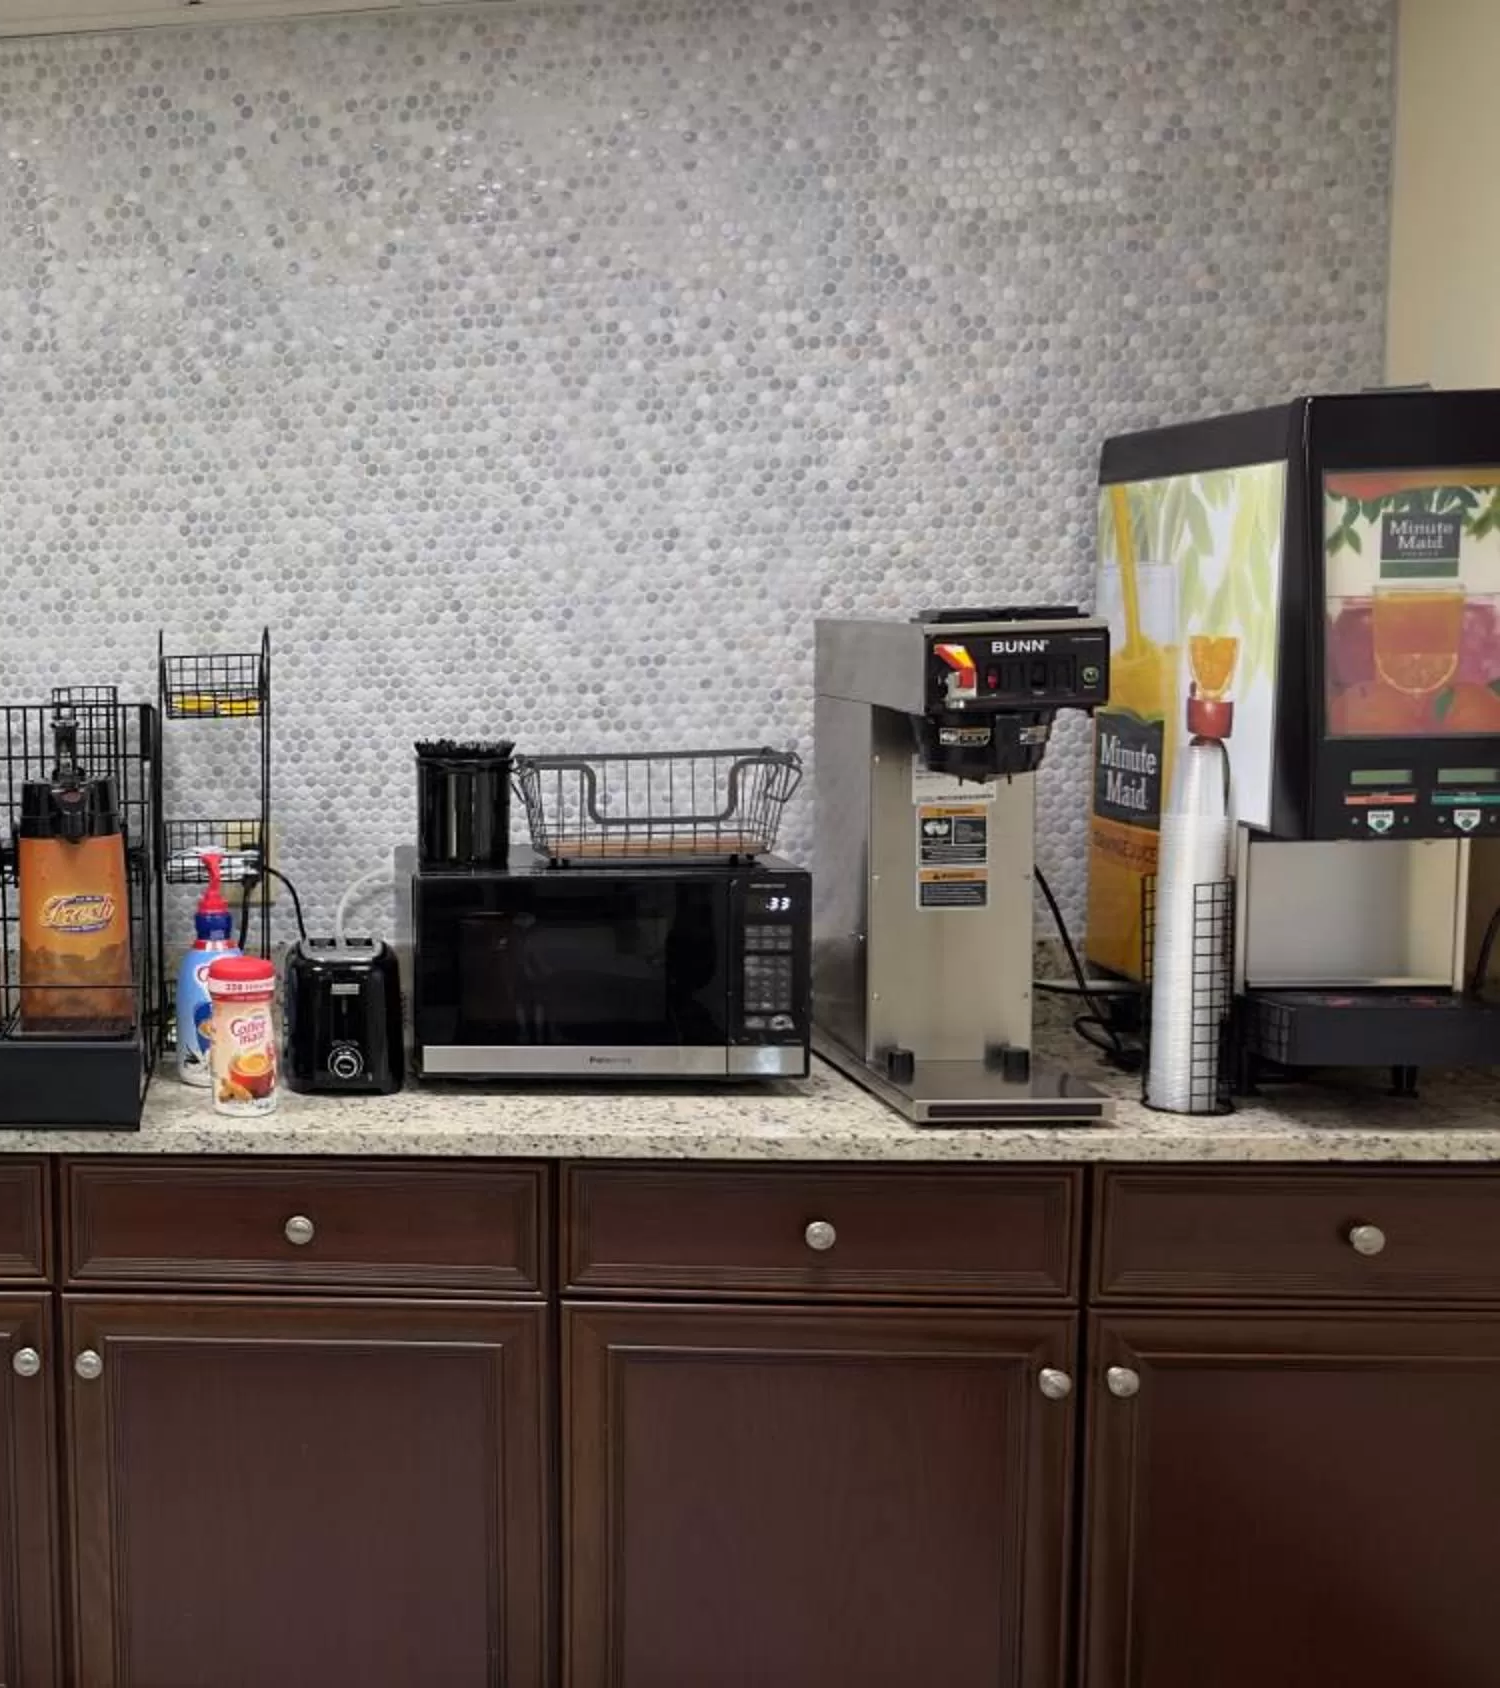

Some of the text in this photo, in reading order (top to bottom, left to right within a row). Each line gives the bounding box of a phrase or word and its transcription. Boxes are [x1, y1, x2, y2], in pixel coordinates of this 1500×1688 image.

[1389, 519, 1454, 537] Minute
[1398, 535, 1445, 549] Maid
[991, 639, 1046, 654] BUNN
[1100, 732, 1157, 775] Minute
[1106, 768, 1148, 811] Maid
